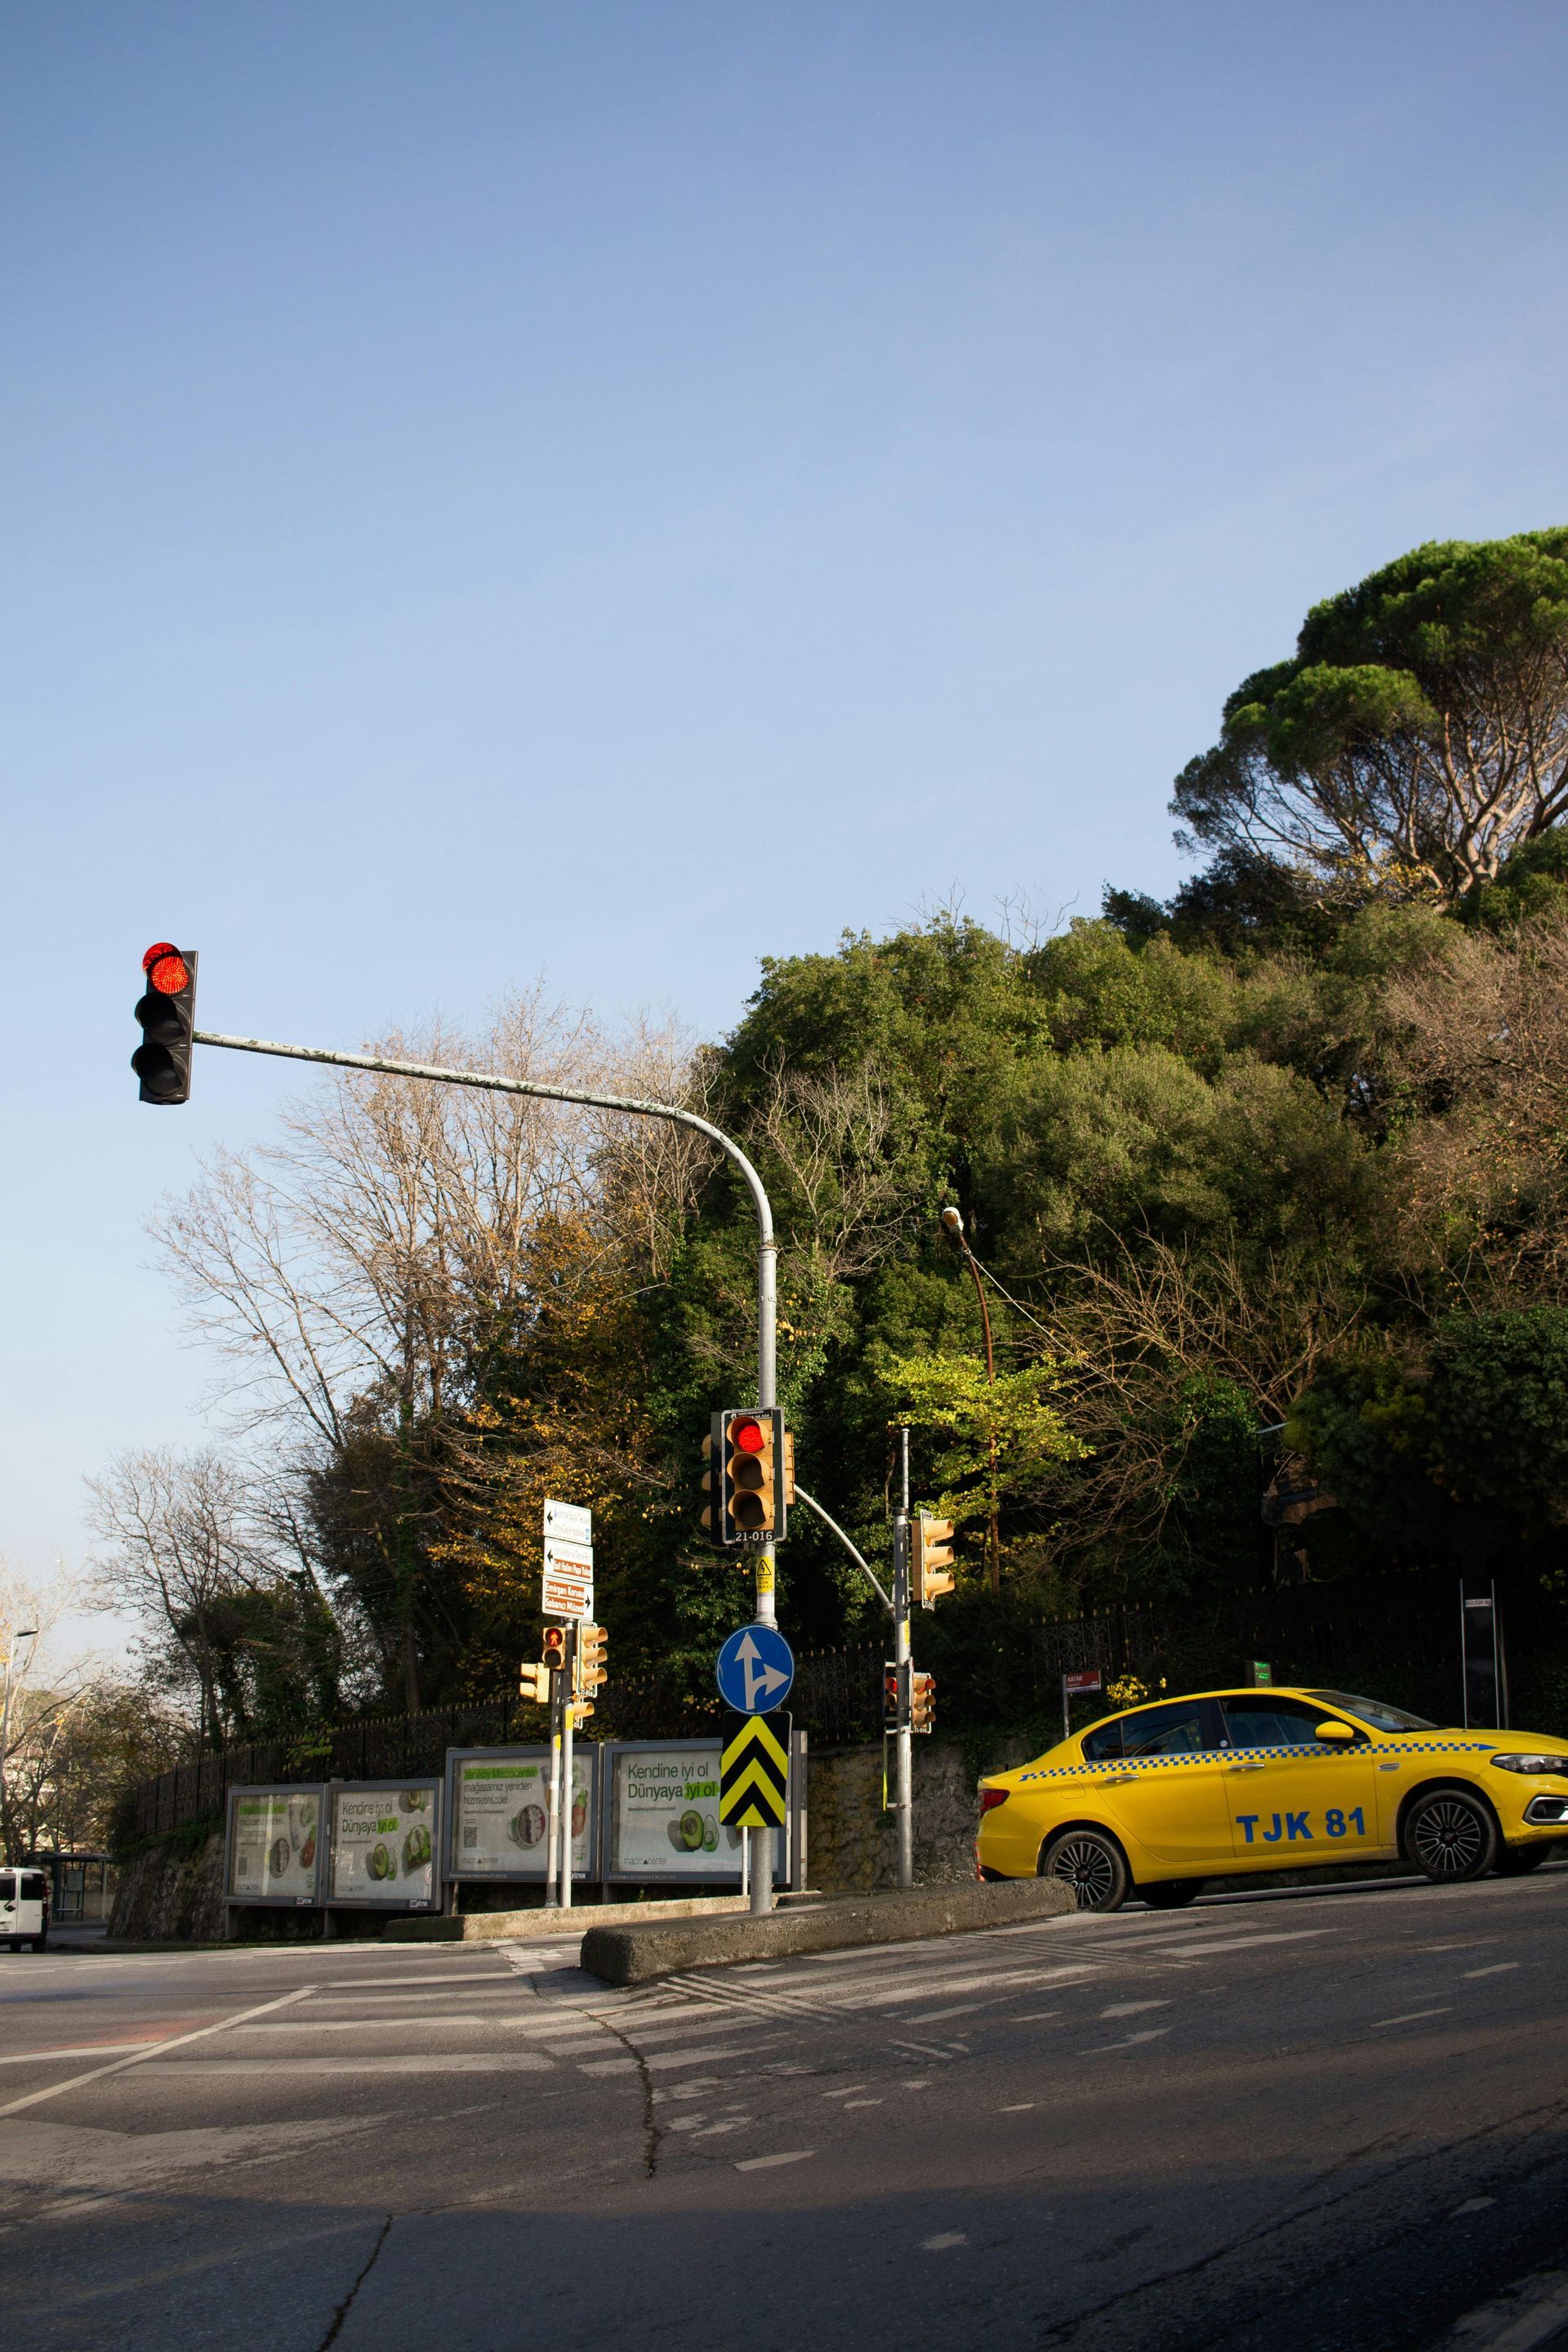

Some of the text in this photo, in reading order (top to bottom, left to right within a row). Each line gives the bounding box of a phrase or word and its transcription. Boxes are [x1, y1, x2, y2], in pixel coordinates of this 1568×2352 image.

[735, 1531, 773, 1542] 21-016
[628, 1762, 708, 1781] Kendine iyi ol
[464, 1780, 532, 1794] mağazamız yeniden
[628, 1781, 715, 1802] Dünyaya iyi ol
[343, 1801, 376, 1815] Kendine
[342, 1819, 376, 1835] Dünyaya
[1236, 1806, 1365, 1843] TJK 81
